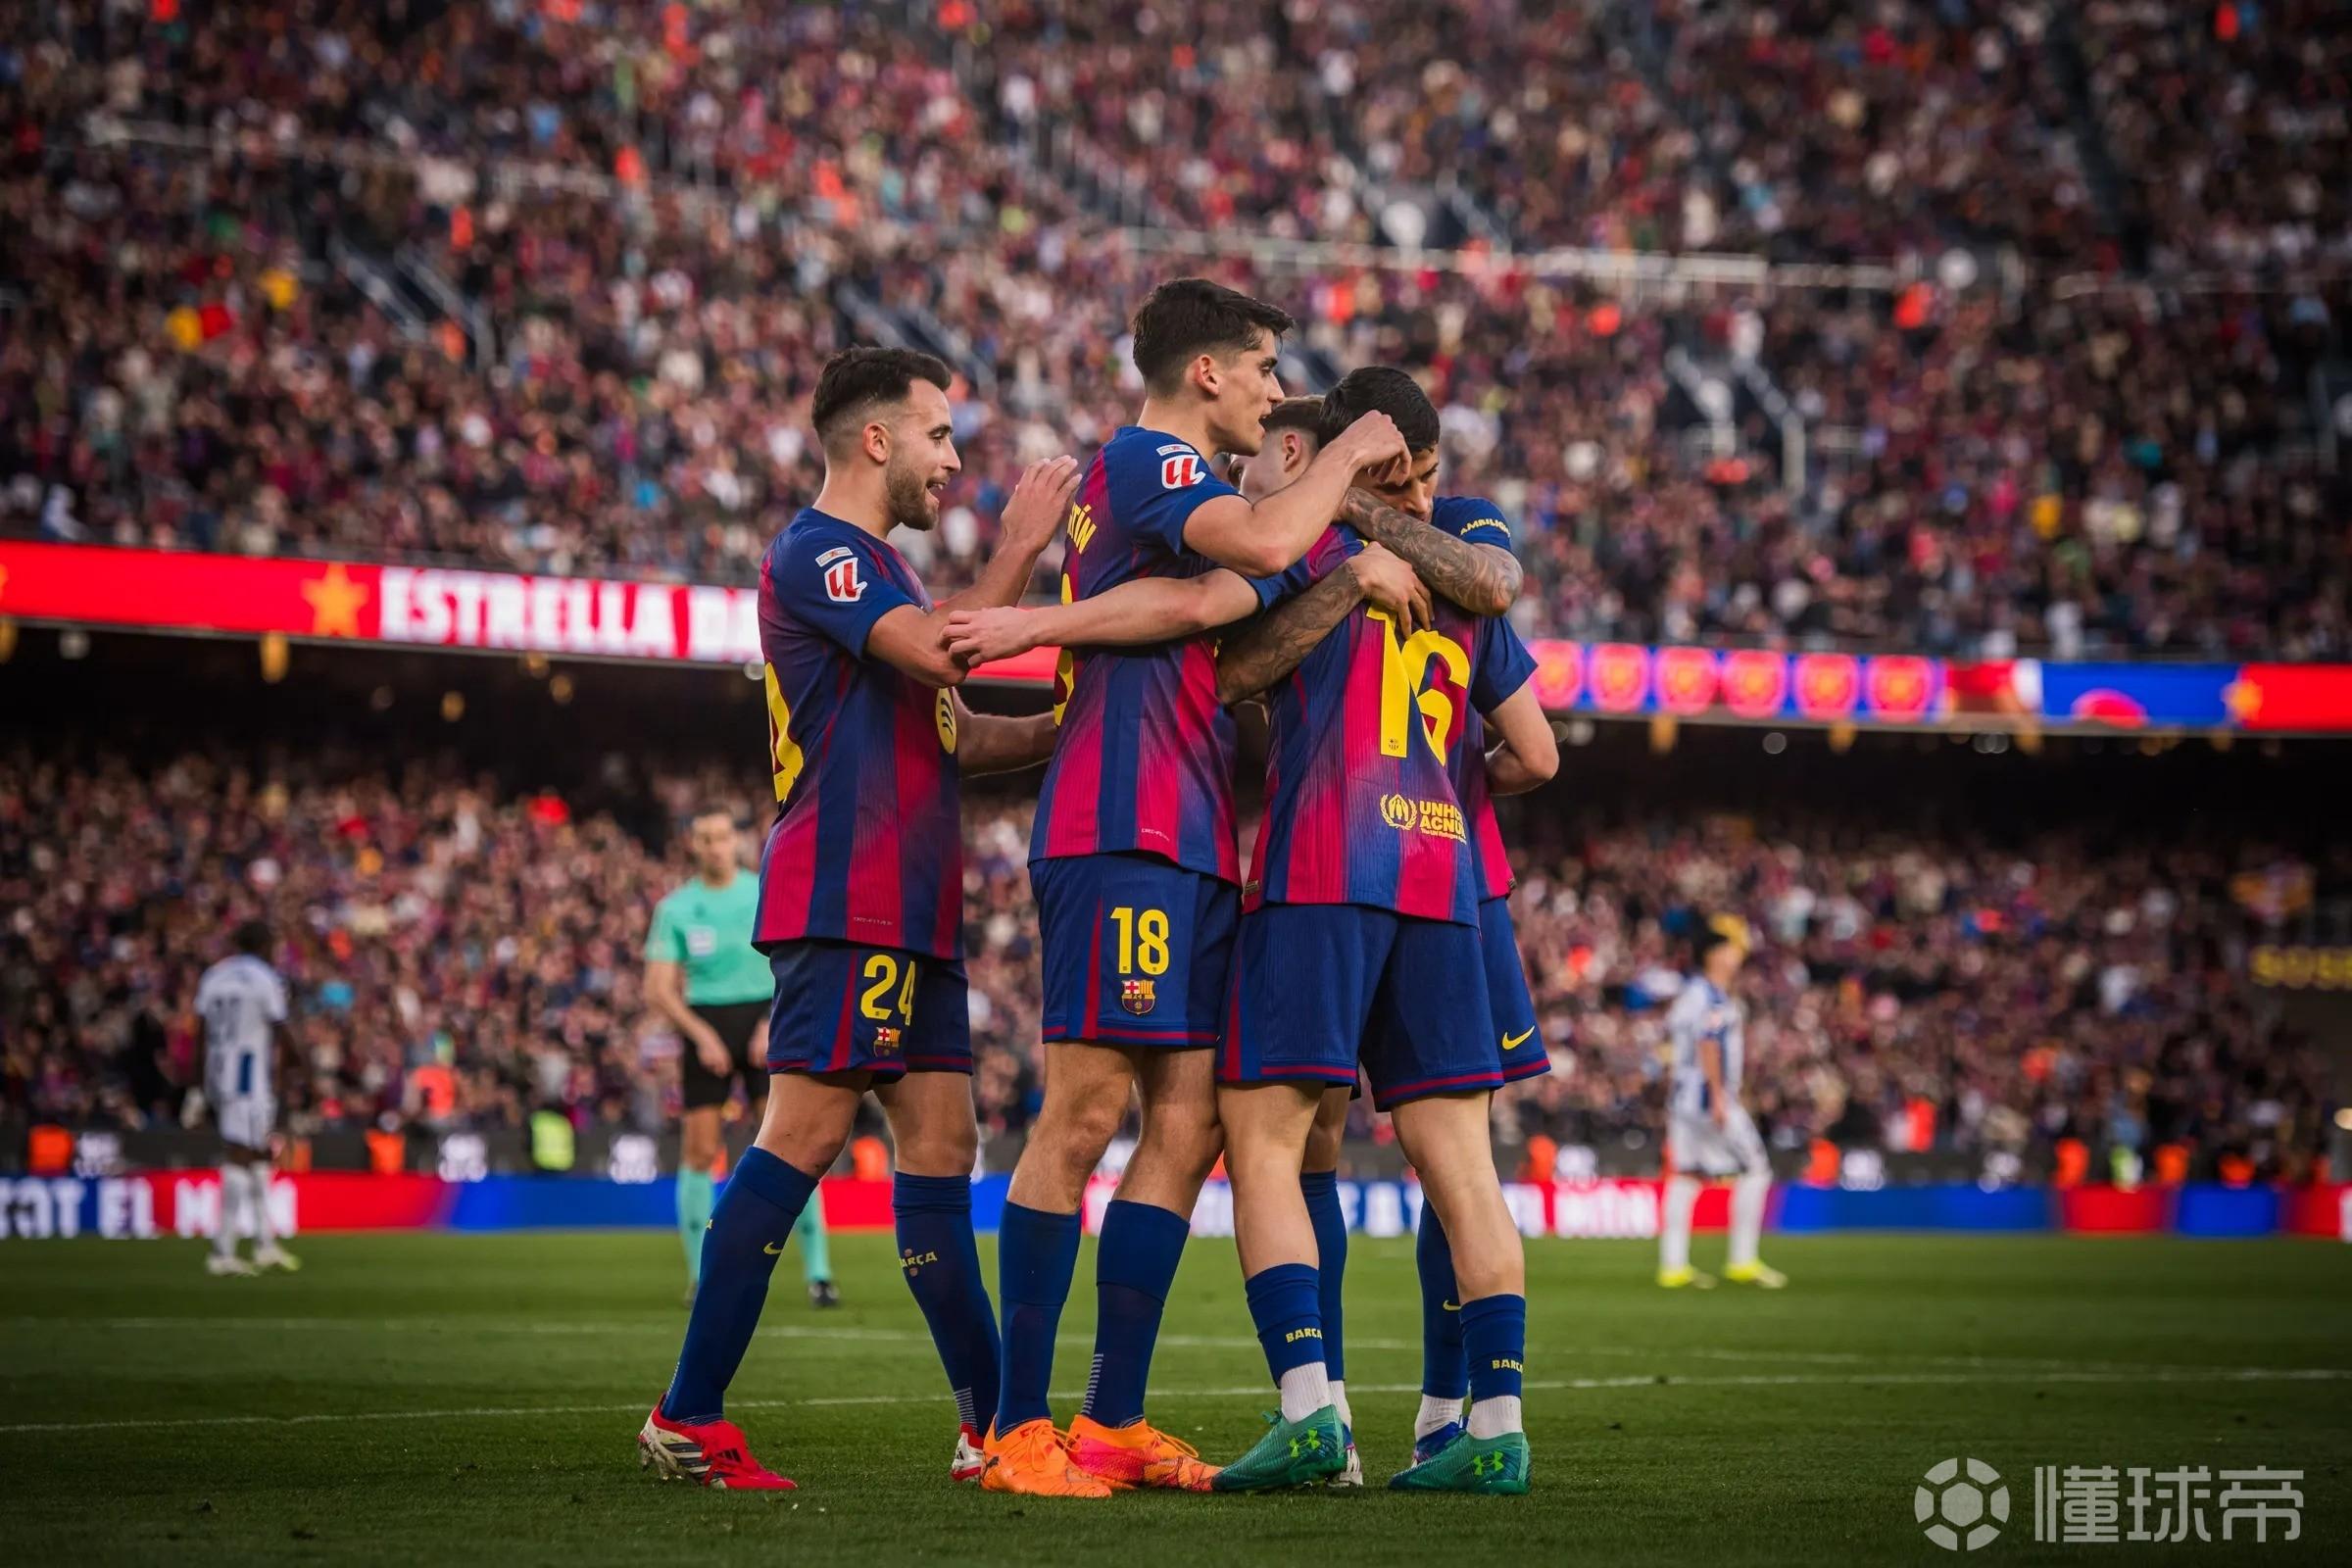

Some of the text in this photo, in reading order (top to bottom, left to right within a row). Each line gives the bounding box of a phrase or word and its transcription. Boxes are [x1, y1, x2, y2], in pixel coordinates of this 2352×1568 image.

[380, 565, 673, 659] ESTRELLA
[1366, 608, 1470, 766] 16
[1110, 907, 1169, 975] 18
[860, 954, 915, 1026] 24
